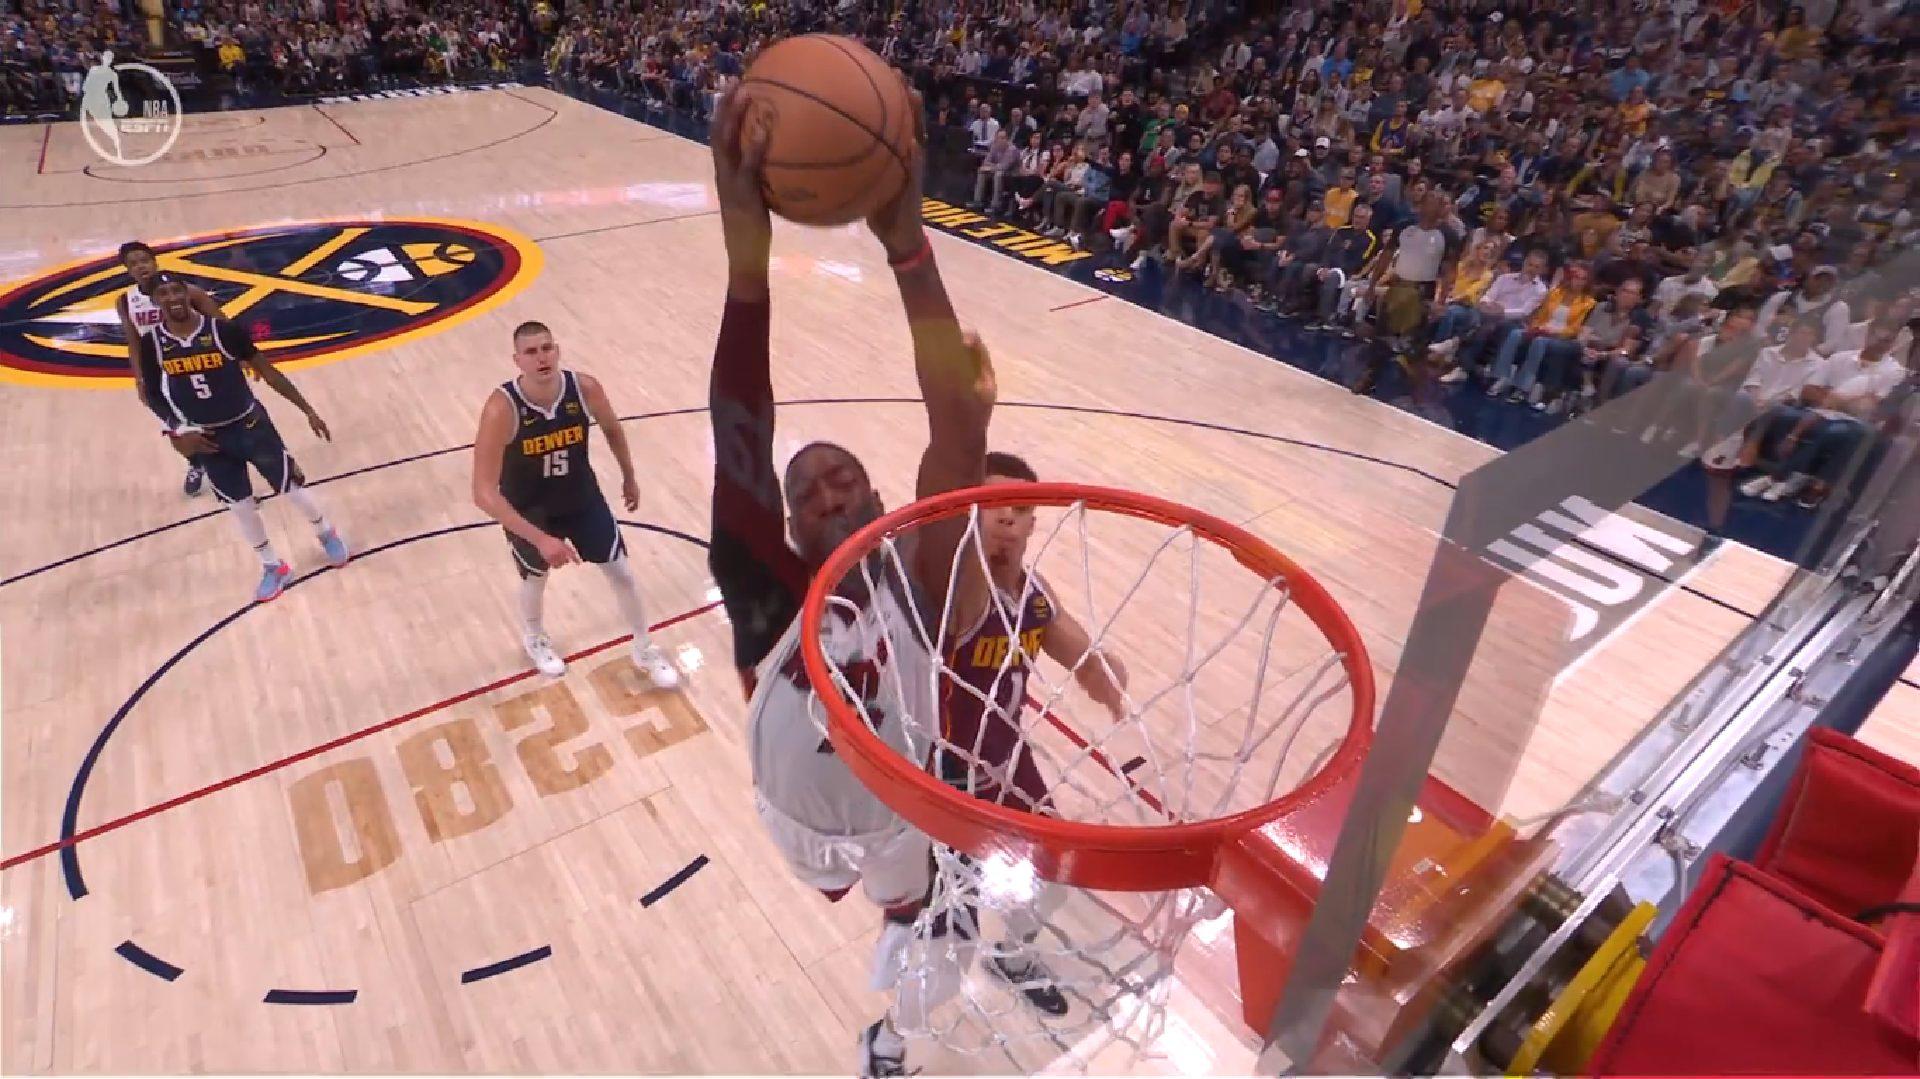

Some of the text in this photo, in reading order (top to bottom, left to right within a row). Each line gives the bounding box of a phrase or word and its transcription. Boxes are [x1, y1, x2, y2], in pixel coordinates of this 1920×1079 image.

[162, 352, 223, 375] DENVER
[189, 373, 213, 400] 5
[522, 423, 585, 456] DENVER
[543, 449, 569, 479] 15
[288, 653, 711, 897] 5280
